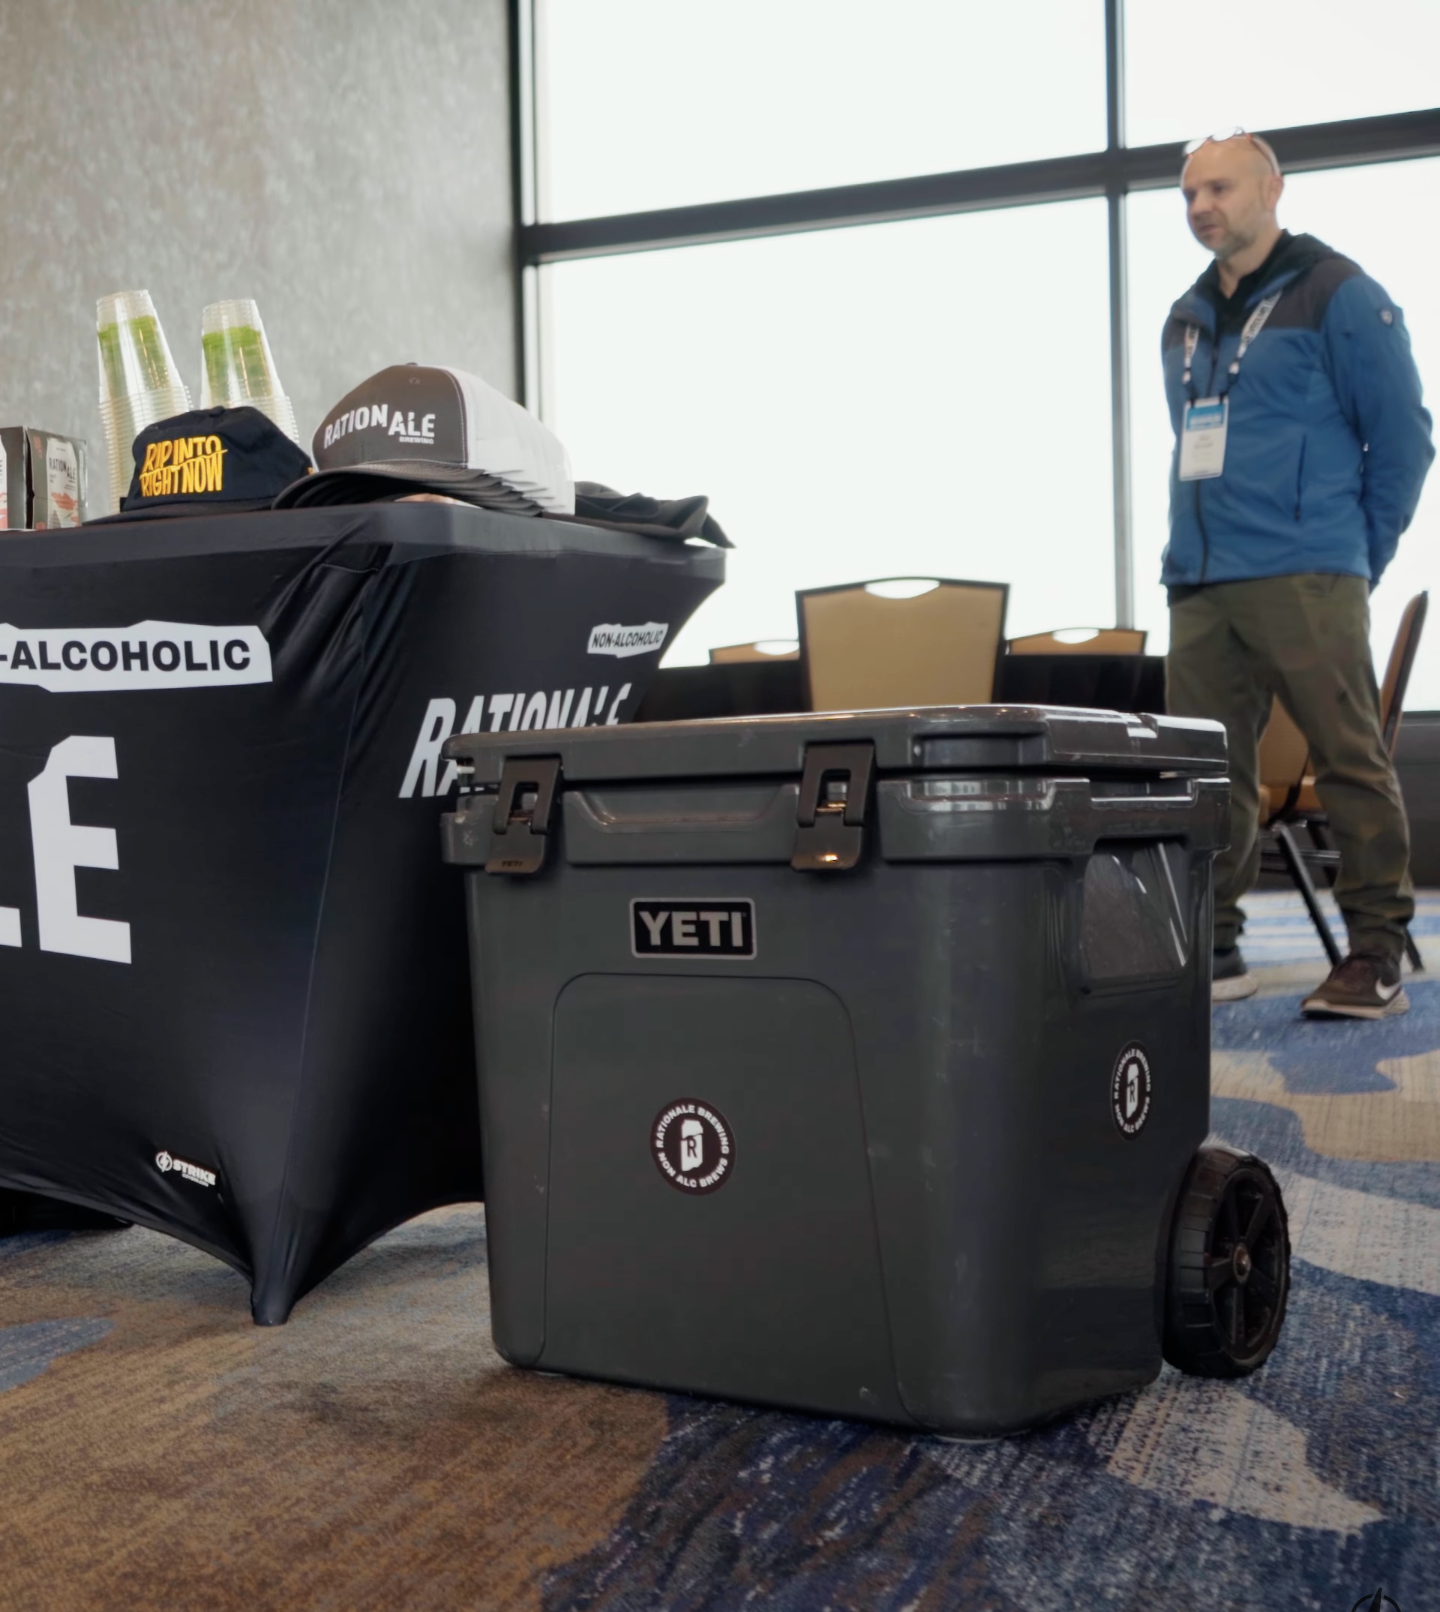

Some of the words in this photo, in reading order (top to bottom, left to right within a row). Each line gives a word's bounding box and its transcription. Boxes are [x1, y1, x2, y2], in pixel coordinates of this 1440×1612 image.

[323, 404, 436, 449] RATIONALE
[399, 436, 434, 444] BREWING
[142, 440, 173, 473] RIP
[172, 435, 222, 465] INTO
[140, 466, 180, 497] RIGHT
[181, 455, 223, 493] NOW
[592, 629, 663, 649] NON-ALCOHOLIC
[638, 910, 744, 948] YETI
[655, 1104, 696, 1148] RATIONALE
[697, 1106, 730, 1155] BREWING
[1123, 1122, 1135, 1133] ALC
[686, 1136, 698, 1159] R
[172, 1158, 216, 1186] STRIKE
[658, 1152, 677, 1177] NON
[675, 1174, 697, 1188] ALC
[699, 1157, 729, 1188] BREWS
